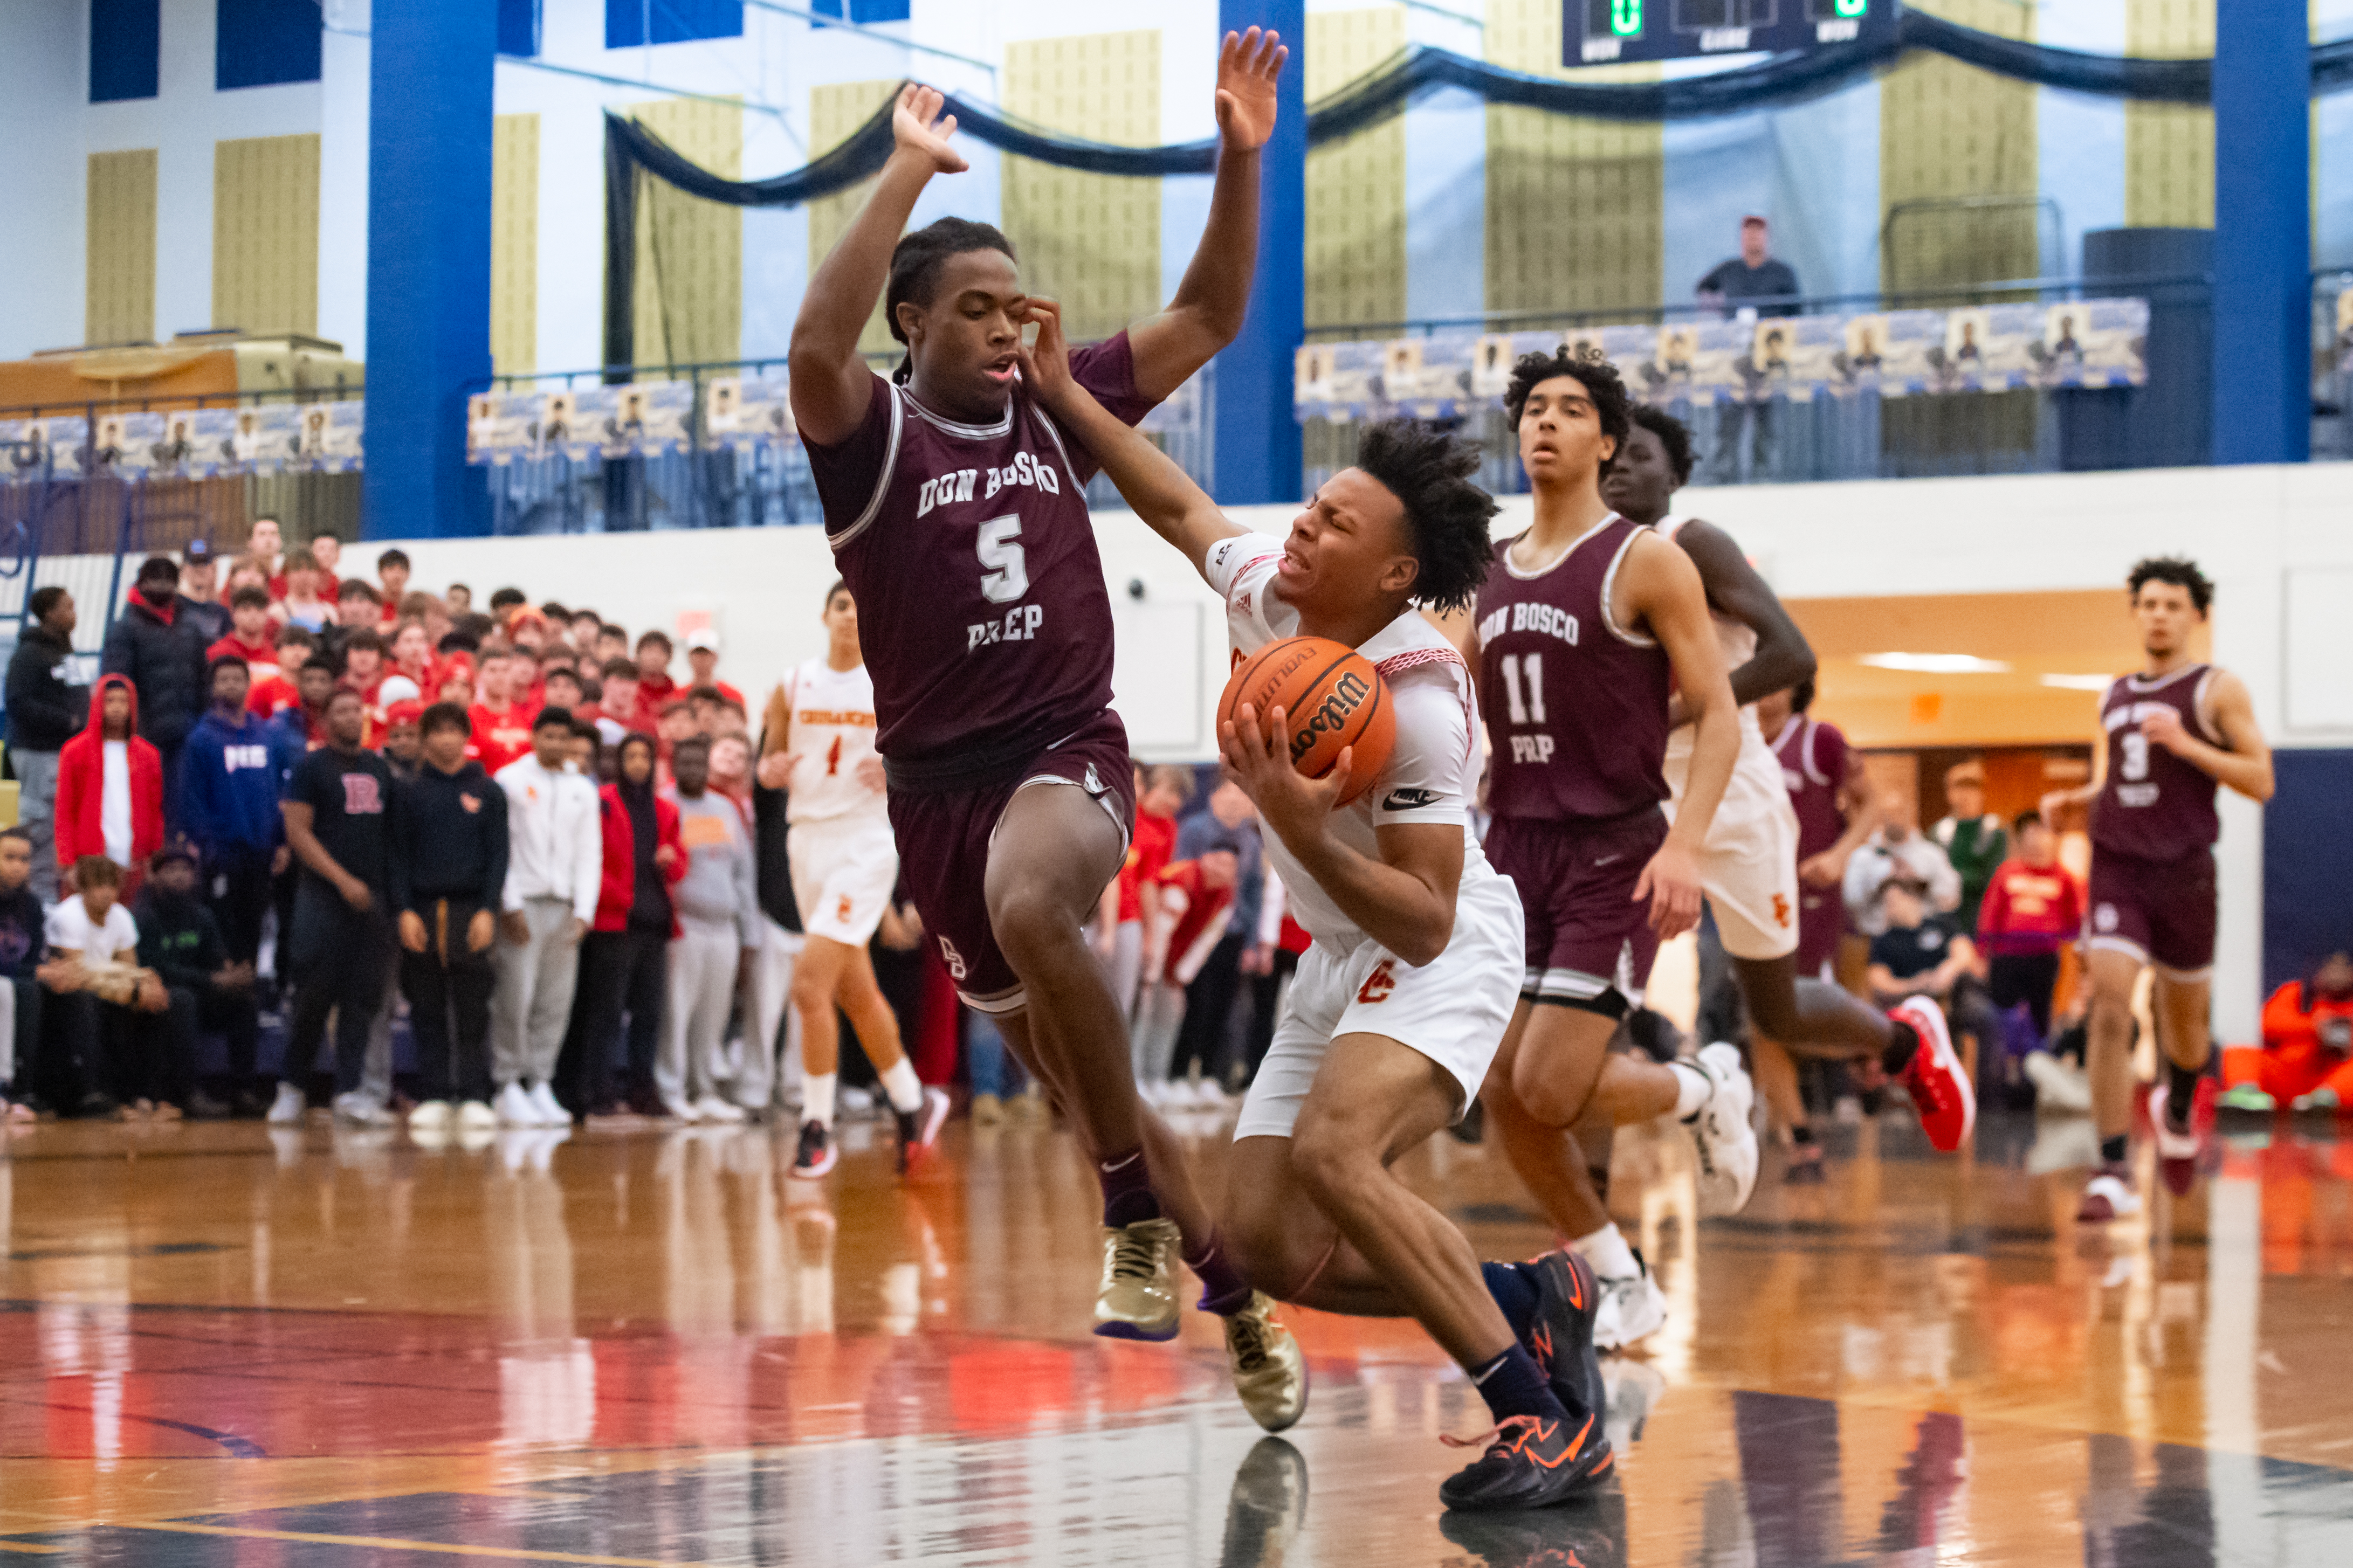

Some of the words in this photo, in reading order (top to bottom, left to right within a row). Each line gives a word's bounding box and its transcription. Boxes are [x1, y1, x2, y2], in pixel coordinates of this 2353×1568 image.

[917, 469, 978, 519] DON
[976, 513, 1029, 604] 5
[1512, 602, 1579, 647] BOSCO
[1501, 652, 1547, 726] 11
[826, 734, 843, 775] 1
[1393, 788, 1430, 803] NIKE
